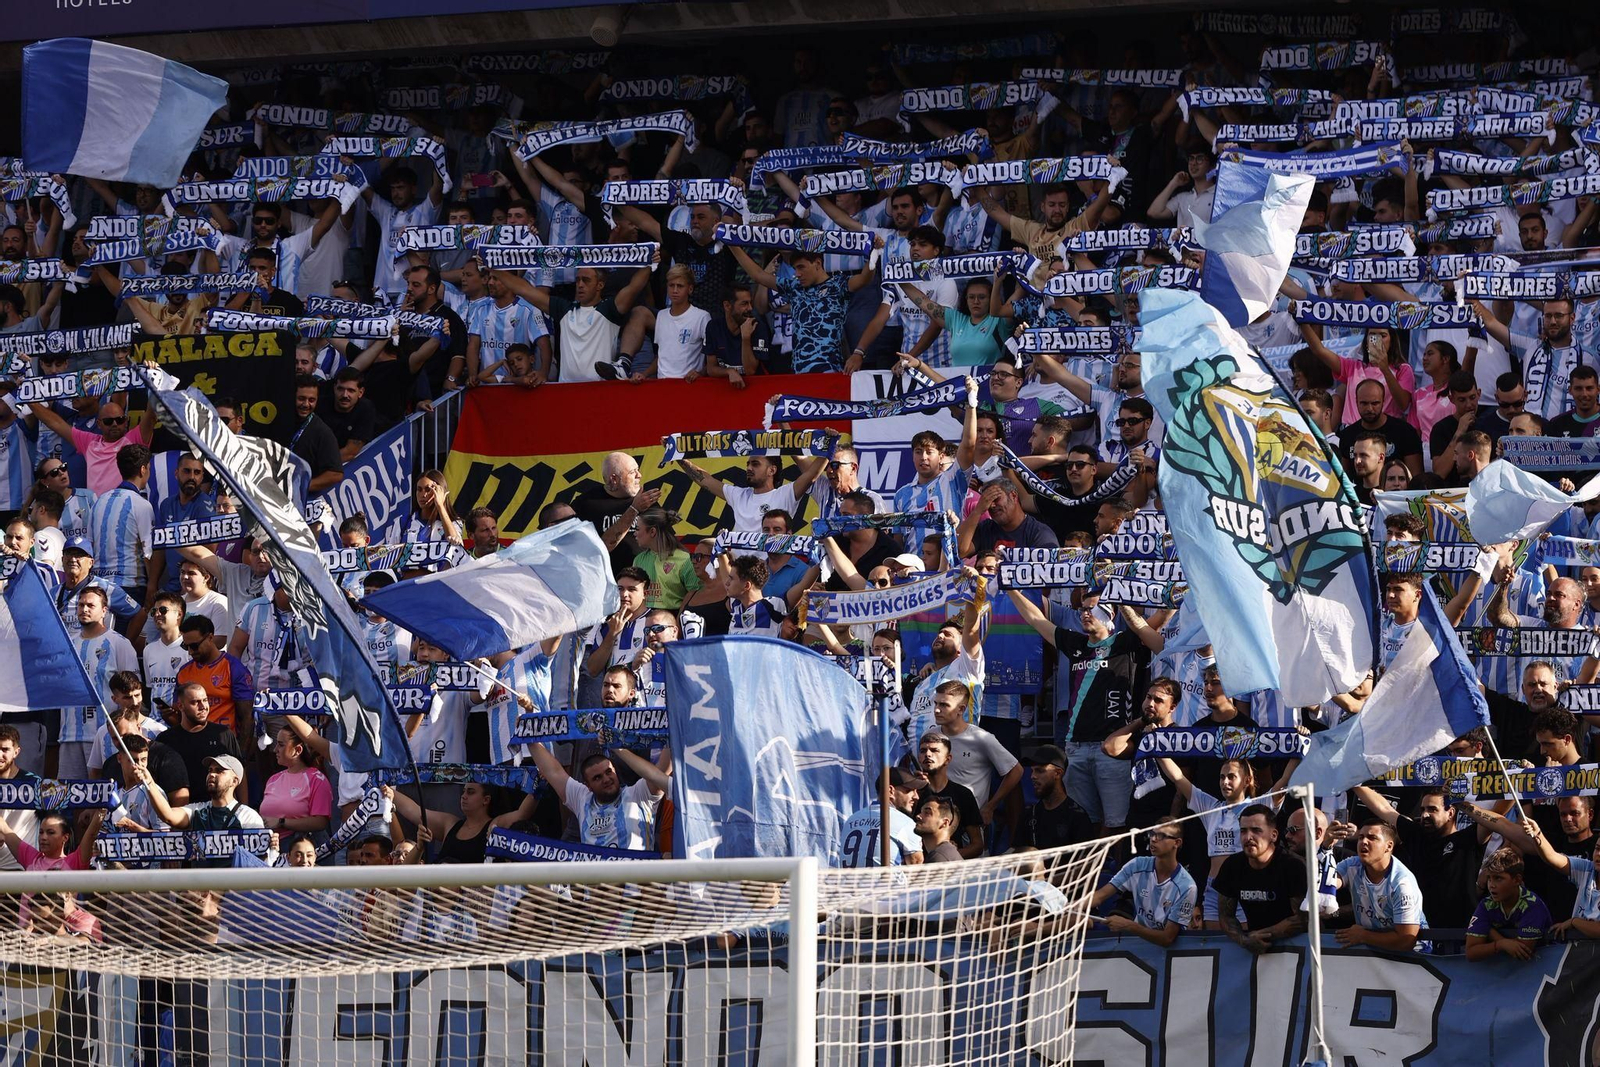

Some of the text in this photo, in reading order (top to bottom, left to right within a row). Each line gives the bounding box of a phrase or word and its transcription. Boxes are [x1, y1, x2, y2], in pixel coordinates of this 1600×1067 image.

[473, 82, 500, 102] SU
[903, 87, 962, 110] ONDO
[1190, 87, 1265, 106] FONDO
[1479, 89, 1536, 112] ONDO
[259, 103, 328, 127] FONDO
[1336, 101, 1398, 120] ONDO
[202, 125, 244, 147] SUR
[1238, 123, 1298, 140] PADRES
[1362, 122, 1382, 140] DE
[1387, 122, 1455, 140] PADRES
[1490, 117, 1543, 137] HIJOS
[931, 130, 976, 154] MALAG
[1440, 150, 1518, 175] FONDO
[805, 170, 867, 195] ONDO
[964, 163, 1023, 186] ONDO
[175, 180, 345, 201] FONDO SUR
[608, 183, 670, 201] PADRES
[1436, 187, 1502, 210] ONDO
[720, 223, 869, 251] FONDO SUR
[1086, 228, 1150, 248] PADRES
[484, 247, 536, 267] FRENTE
[1354, 257, 1419, 281] PADRES
[1050, 268, 1113, 294] ONDO
[1466, 279, 1486, 297] DE
[1491, 278, 1557, 297] PADRES
[1296, 304, 1390, 324] FONDO
[336, 317, 388, 337] SUR
[66, 330, 79, 351] NI
[132, 331, 282, 365] MÁLAGA
[1040, 332, 1113, 351] PADRES
[19, 373, 77, 399] ONDO
[783, 398, 866, 419] FONDO
[906, 383, 956, 410] SUR
[676, 431, 813, 454] ULTRAS MALAGA
[153, 516, 242, 547] DE PADRES
[1425, 545, 1480, 569] SUR
[1000, 562, 1087, 585] FONDO
[840, 583, 944, 618] INVENCIBLES
[394, 685, 424, 707] UR
[1107, 689, 1120, 718] UAX
[120, 829, 188, 854] PADRES
[842, 832, 880, 868] 91
[1026, 951, 1445, 1067] SUR
